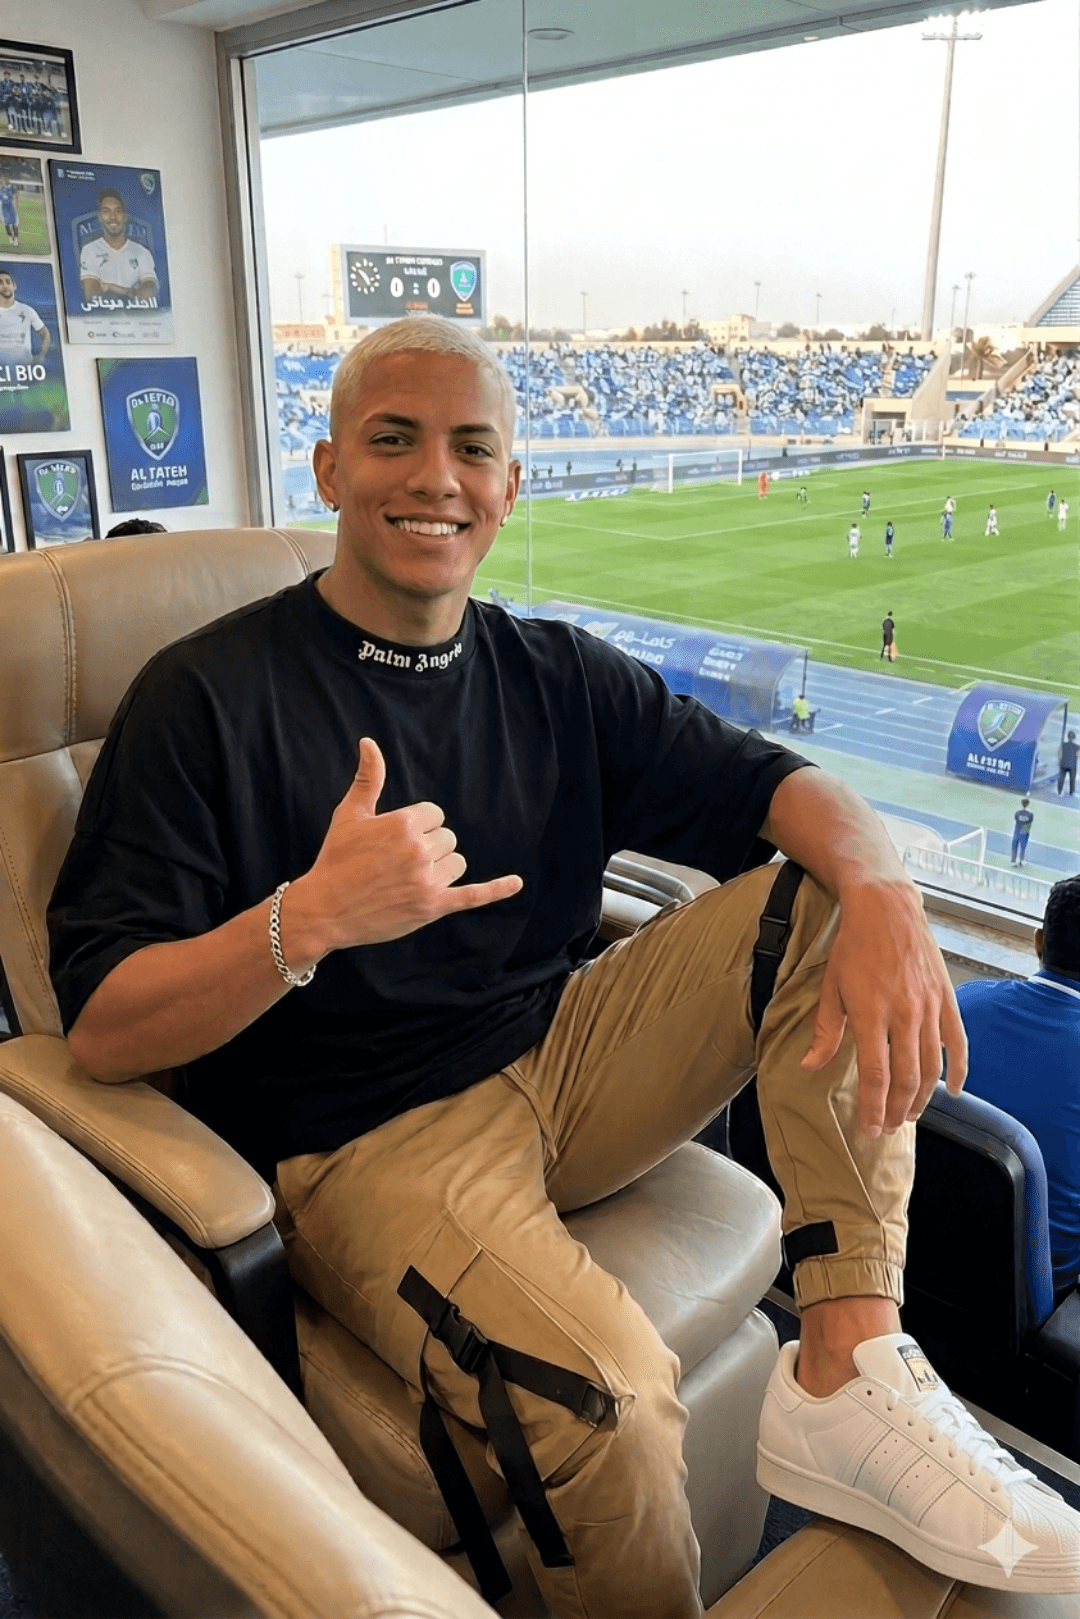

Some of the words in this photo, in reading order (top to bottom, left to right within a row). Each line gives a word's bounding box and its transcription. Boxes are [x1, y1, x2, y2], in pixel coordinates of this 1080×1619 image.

[390, 277, 404, 298] 0
[427, 277, 441, 298] 0
[15, 364, 46, 381] BIO
[131, 468, 147, 481] AL
[149, 465, 187, 480] TATEH
